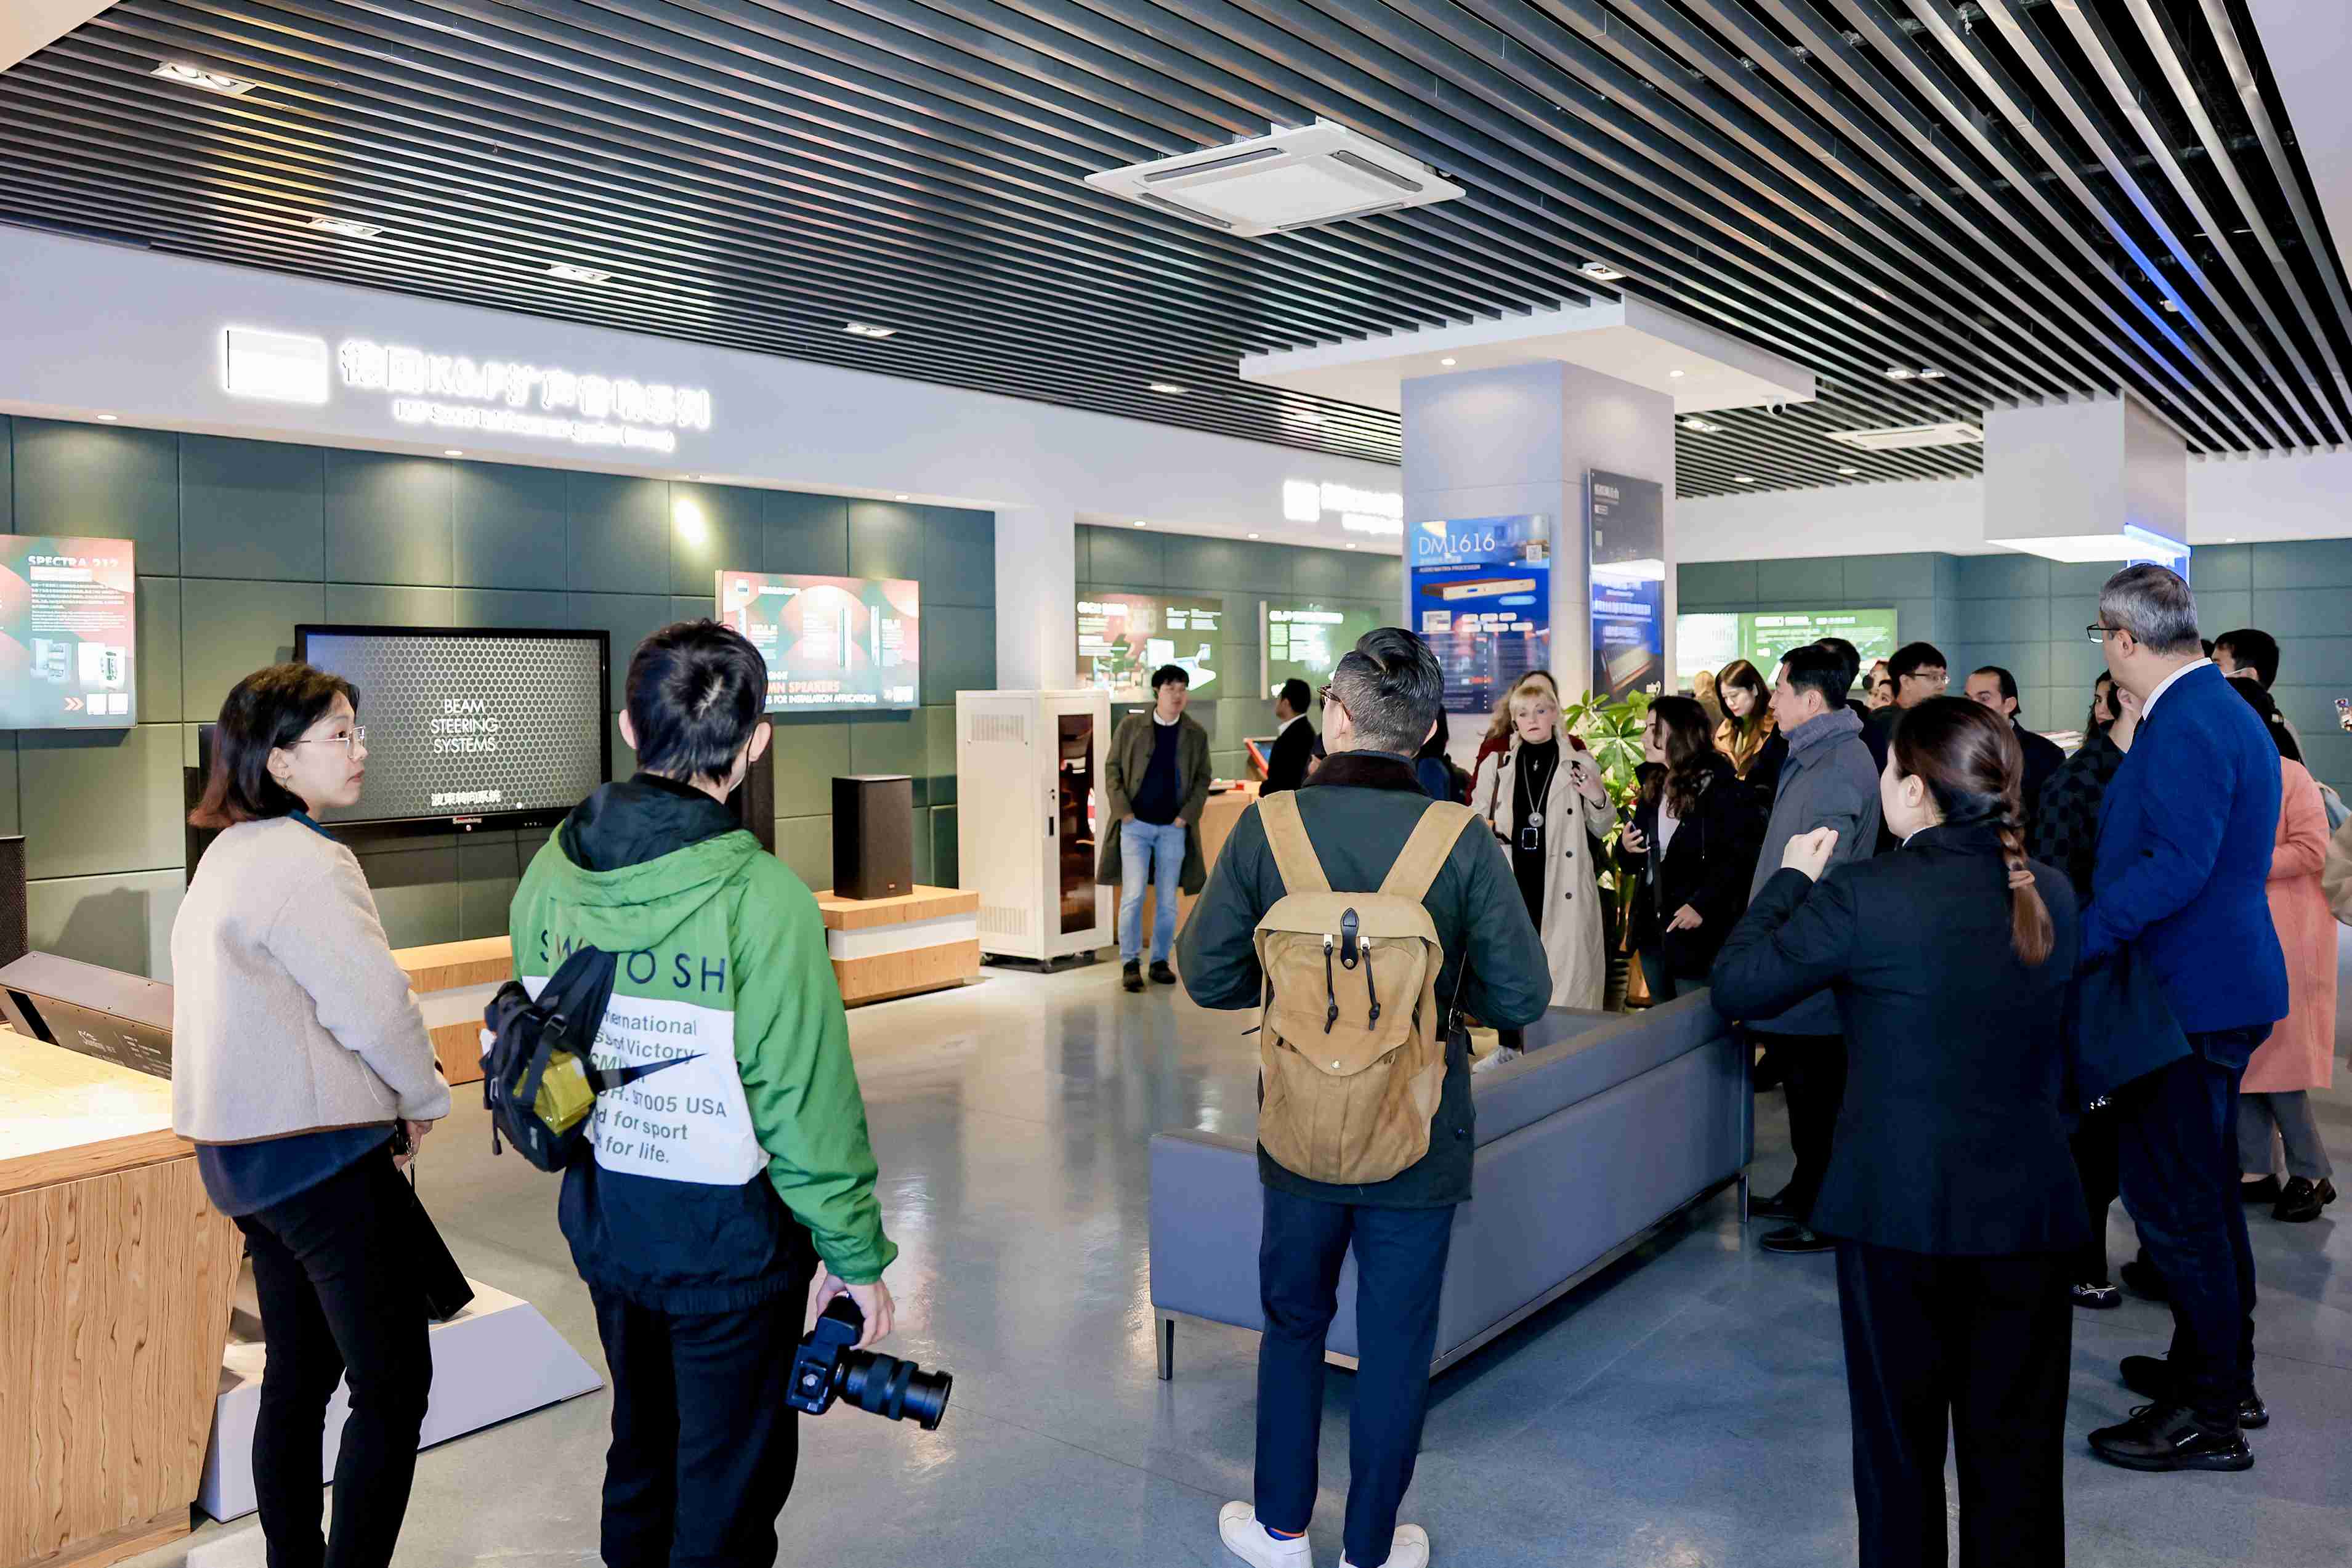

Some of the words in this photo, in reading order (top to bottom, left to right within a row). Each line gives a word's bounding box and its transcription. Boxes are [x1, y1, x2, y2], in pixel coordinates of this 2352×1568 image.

[1419, 532, 1495, 555] DM1616
[28, 555, 86, 567] SPECTRA
[444, 698, 485, 714] BEAM
[431, 717, 498, 734] STEERING
[434, 737, 496, 754] SYSTEMS
[626, 1039, 695, 1065] Victory
[687, 1097, 727, 1118] USA
[613, 1110, 639, 1130] for
[642, 1121, 688, 1140] sport
[605, 1136, 634, 1156] for
[639, 1142, 669, 1163] life.
